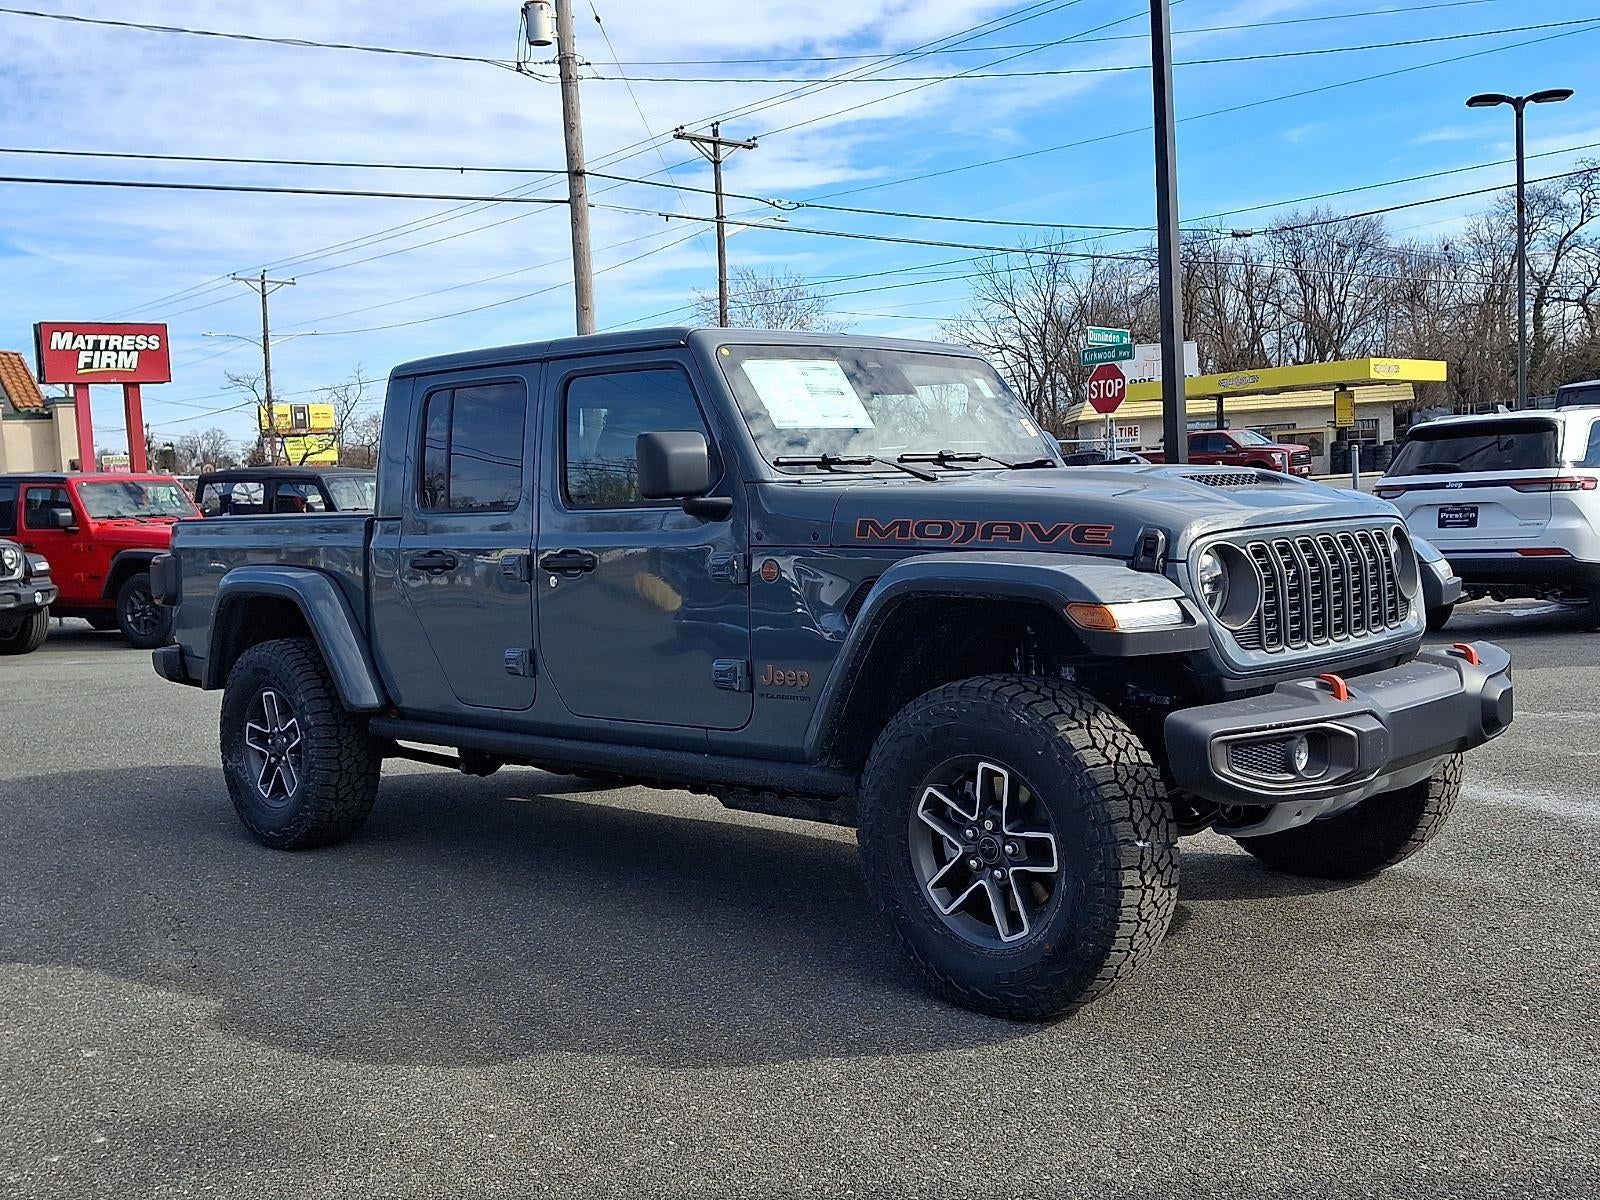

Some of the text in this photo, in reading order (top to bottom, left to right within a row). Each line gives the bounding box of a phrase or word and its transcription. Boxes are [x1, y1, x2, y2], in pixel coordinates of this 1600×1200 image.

[50, 331, 160, 350] MATTRESS
[1089, 331, 1120, 343] Dunlinden
[77, 351, 139, 369] FIRM
[1084, 349, 1116, 362] Kirkwood
[1090, 378, 1124, 400] STOP
[1118, 426, 1139, 438] TIRE
[855, 518, 1115, 547] MOJAVE
[760, 664, 811, 691] Jeep
